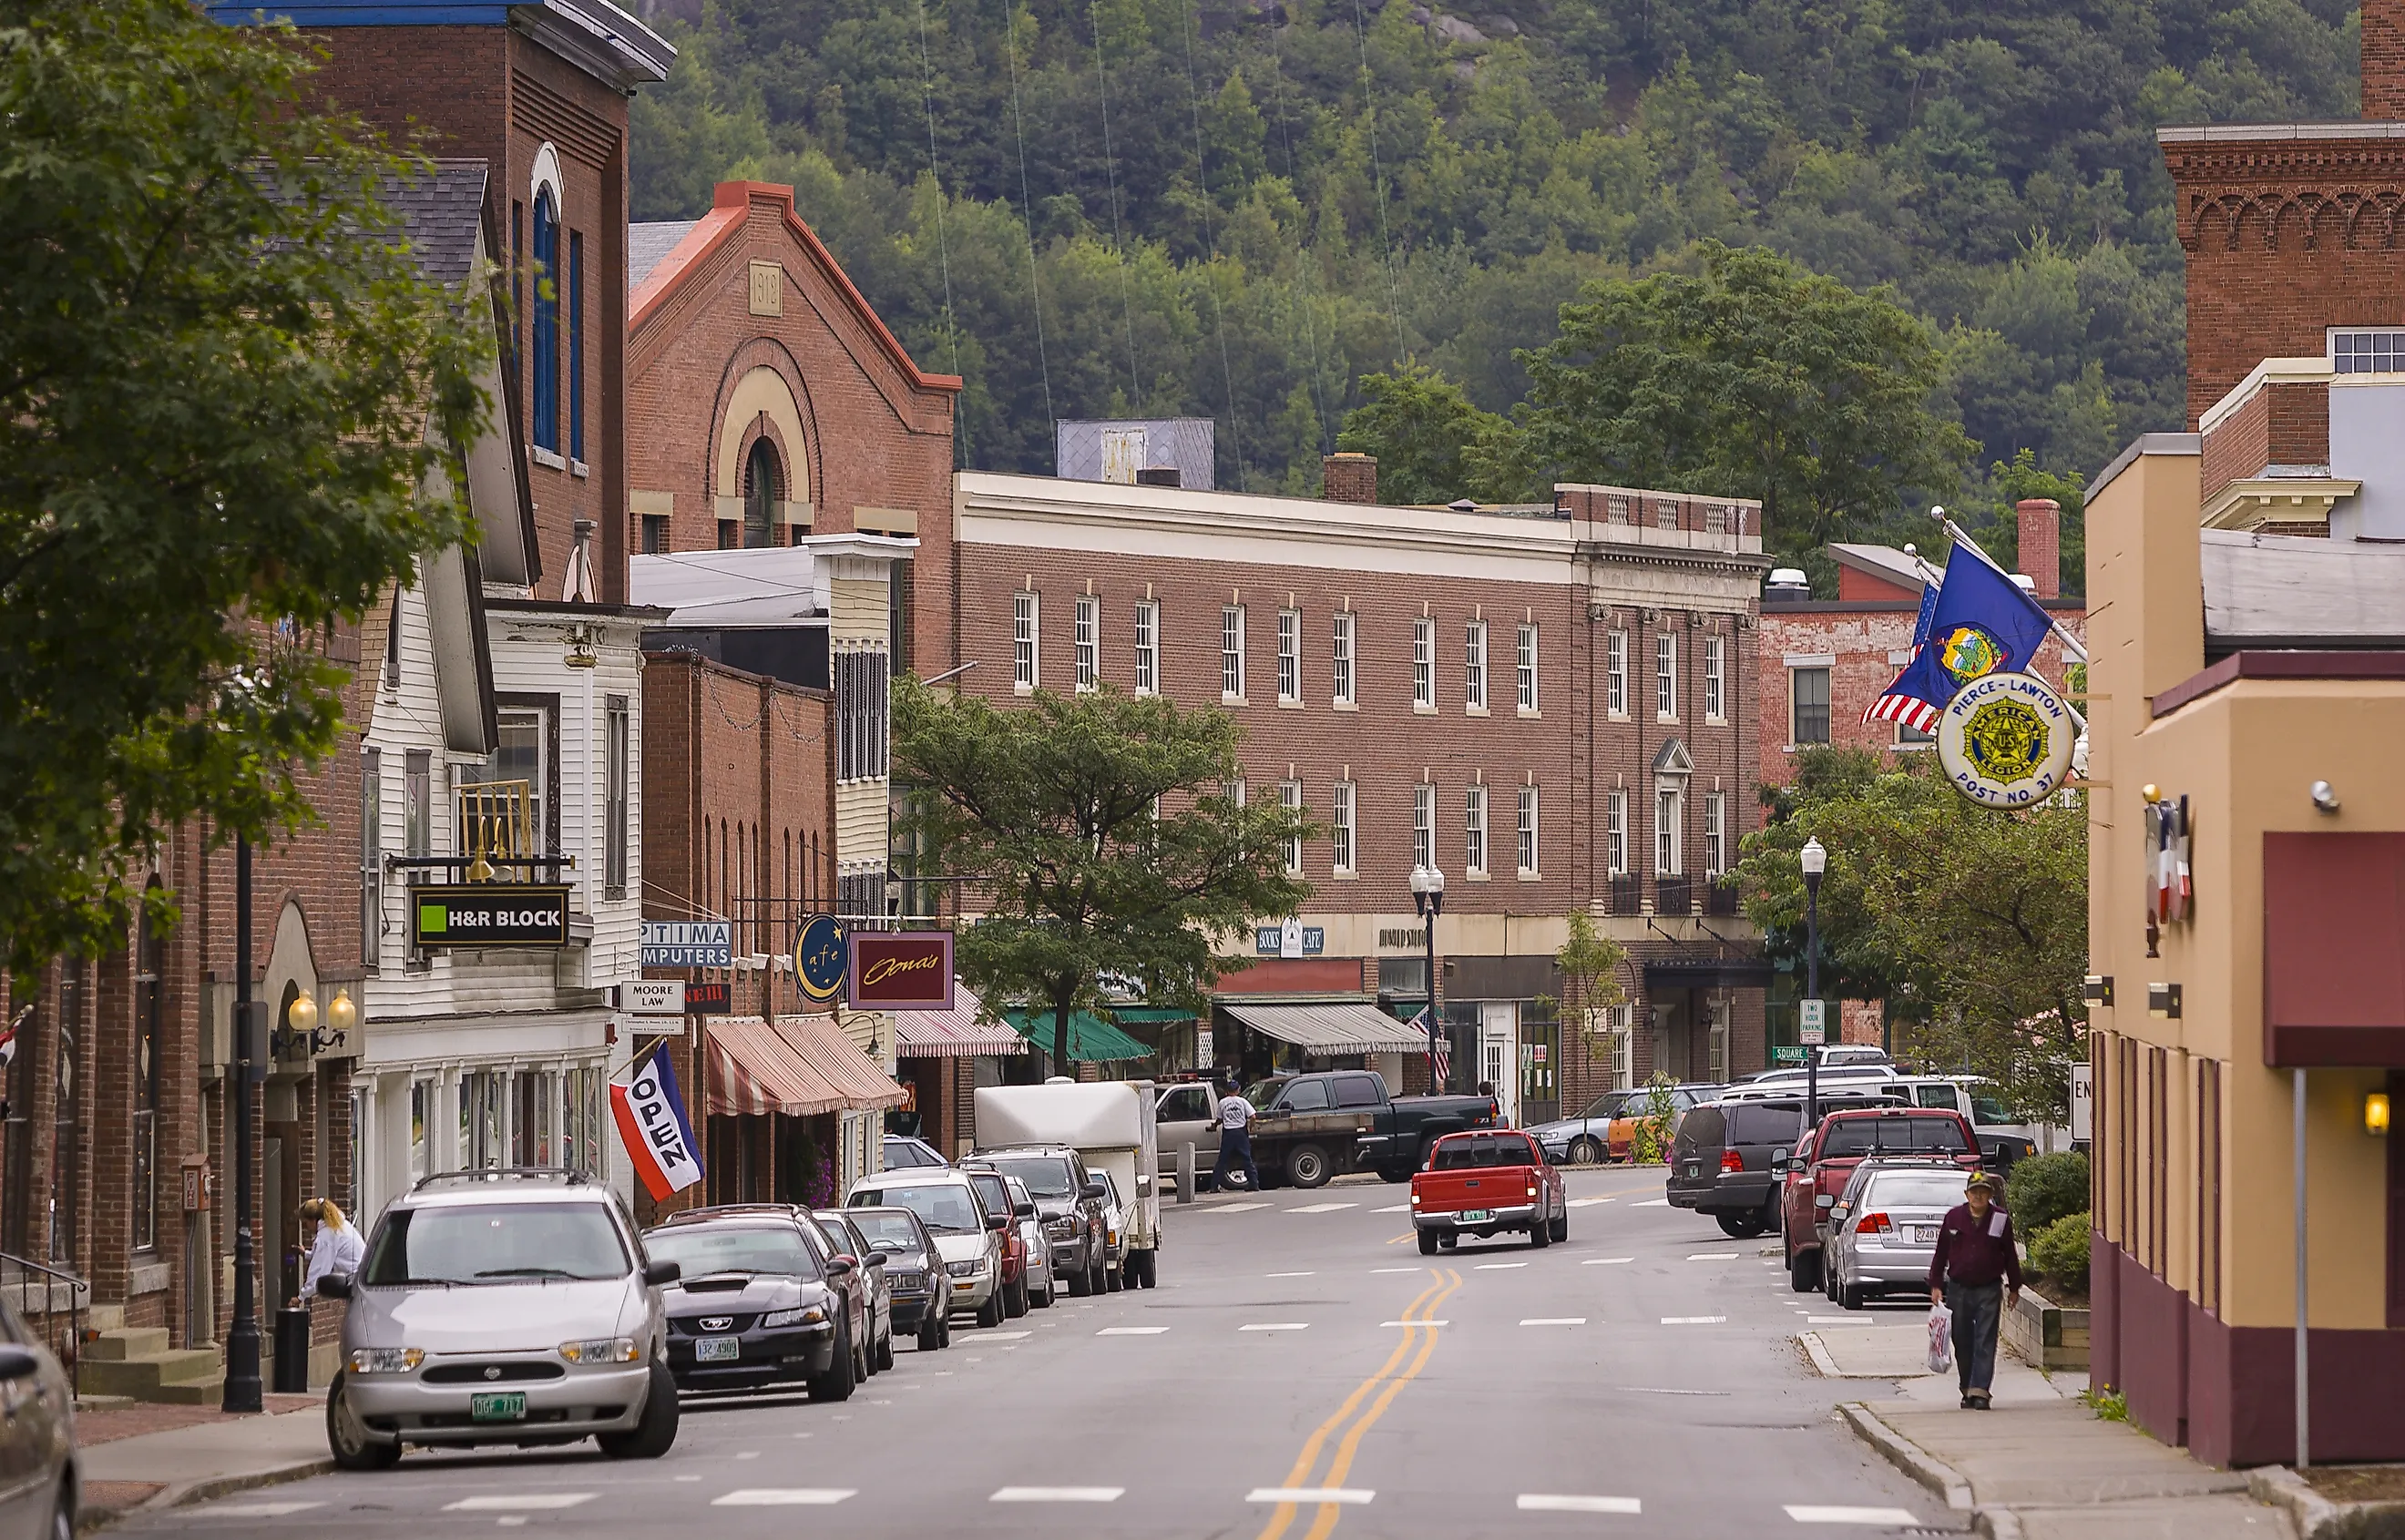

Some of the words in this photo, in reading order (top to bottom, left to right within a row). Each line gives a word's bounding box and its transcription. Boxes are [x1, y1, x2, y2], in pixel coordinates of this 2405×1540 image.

[1973, 708, 2041, 739] AMERICAN
[1980, 759, 2032, 775] LEGION
[1957, 771, 1999, 802] POST
[2007, 790, 2034, 803] NO.
[2036, 772, 2054, 791] 37
[449, 911, 491, 926] H&R
[496, 911, 560, 927] BLOCK
[641, 924, 728, 943] PTIMA
[642, 948, 729, 964] MPUTERS
[632, 985, 674, 995] MOORE
[641, 997, 665, 1006] LAW
[1776, 1048, 1804, 1059] SQUARE
[631, 1078, 687, 1169] OPEN
[186, 1172, 195, 1208] FIRE
